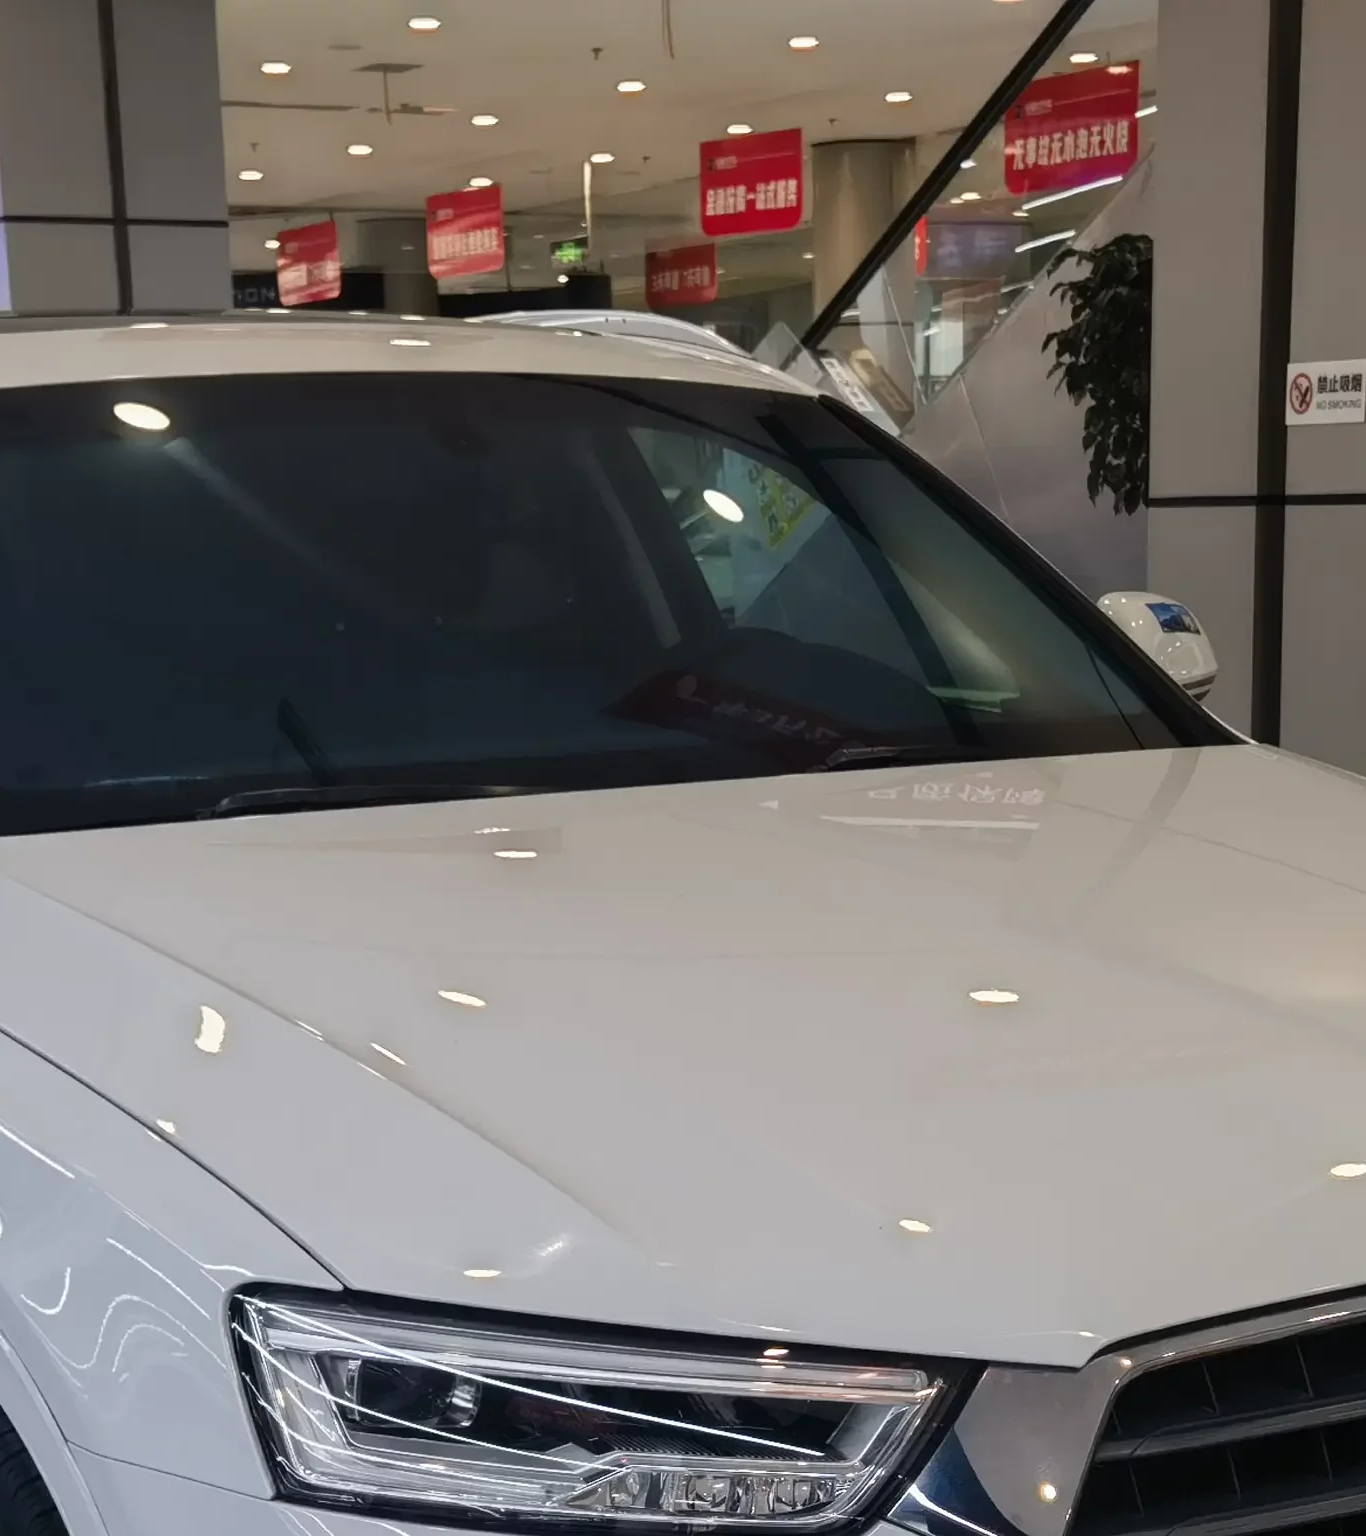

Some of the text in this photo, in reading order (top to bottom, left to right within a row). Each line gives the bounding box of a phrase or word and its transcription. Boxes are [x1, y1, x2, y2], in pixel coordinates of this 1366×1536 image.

[1317, 373, 1363, 394] 禁止吸烟
[1317, 398, 1362, 411] NO SMOKING
